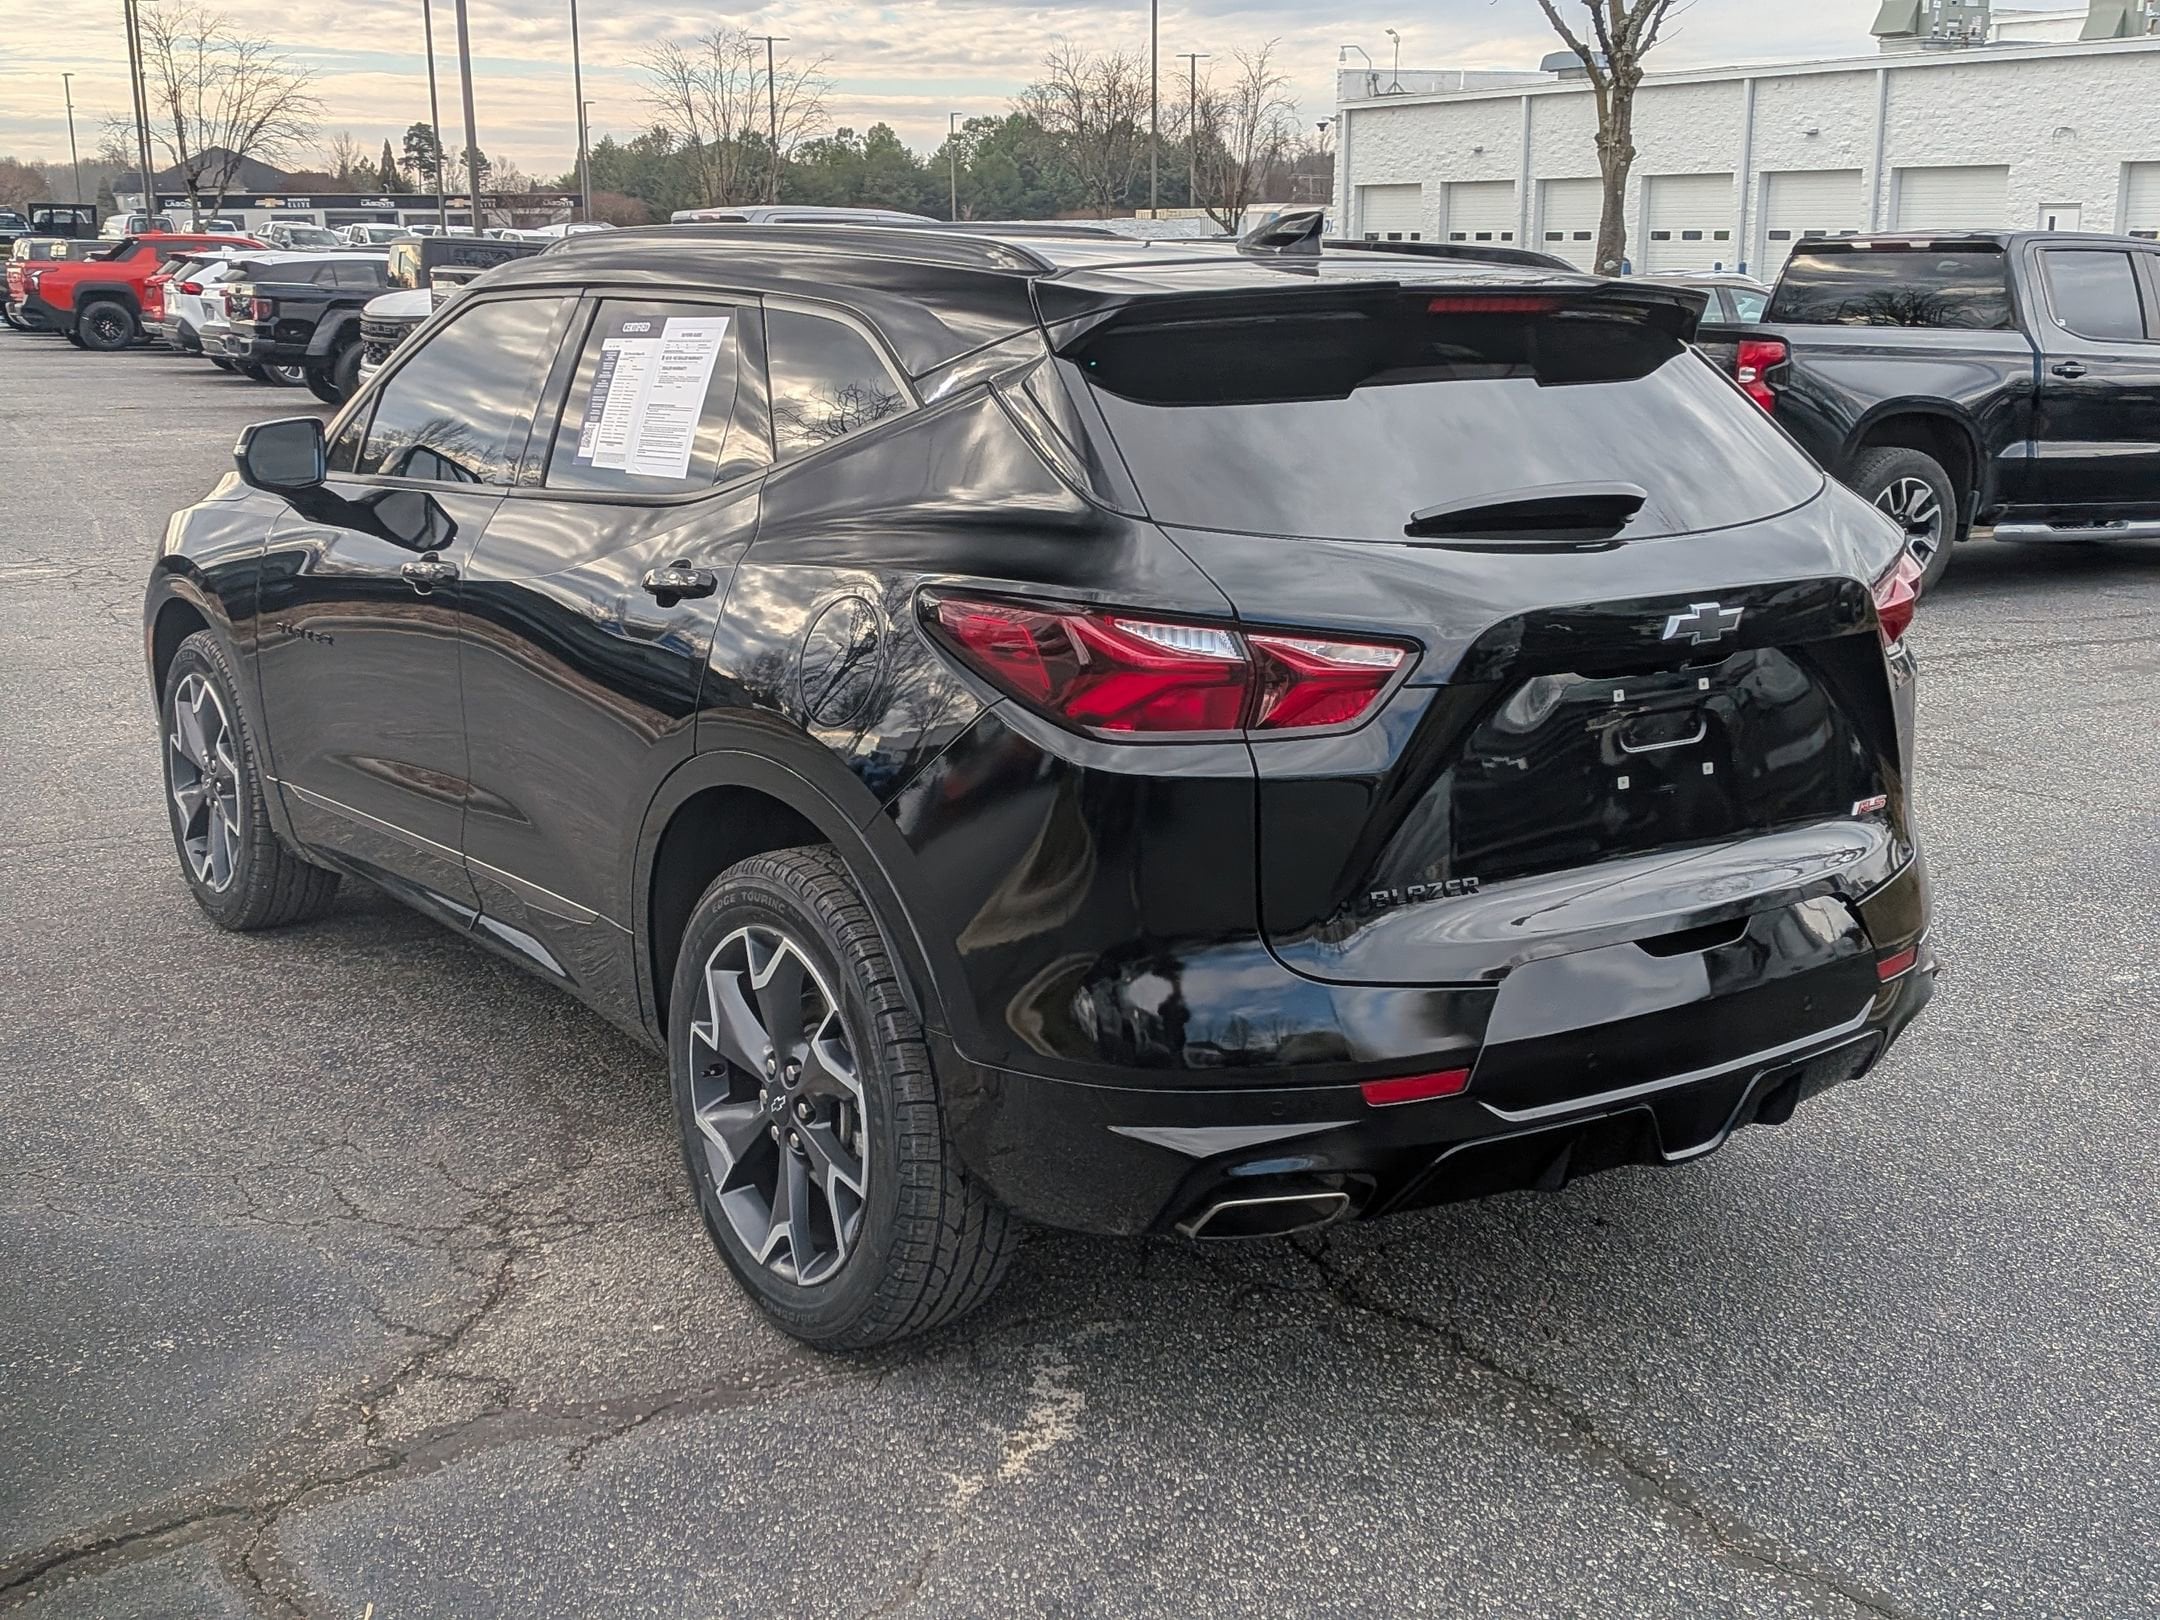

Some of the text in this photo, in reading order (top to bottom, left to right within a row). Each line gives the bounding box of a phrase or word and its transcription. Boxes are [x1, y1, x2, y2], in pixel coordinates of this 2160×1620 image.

[711, 893, 737, 914] EDGE
[740, 889, 786, 914] TOURING
[1370, 877, 1479, 907] BLAZER
